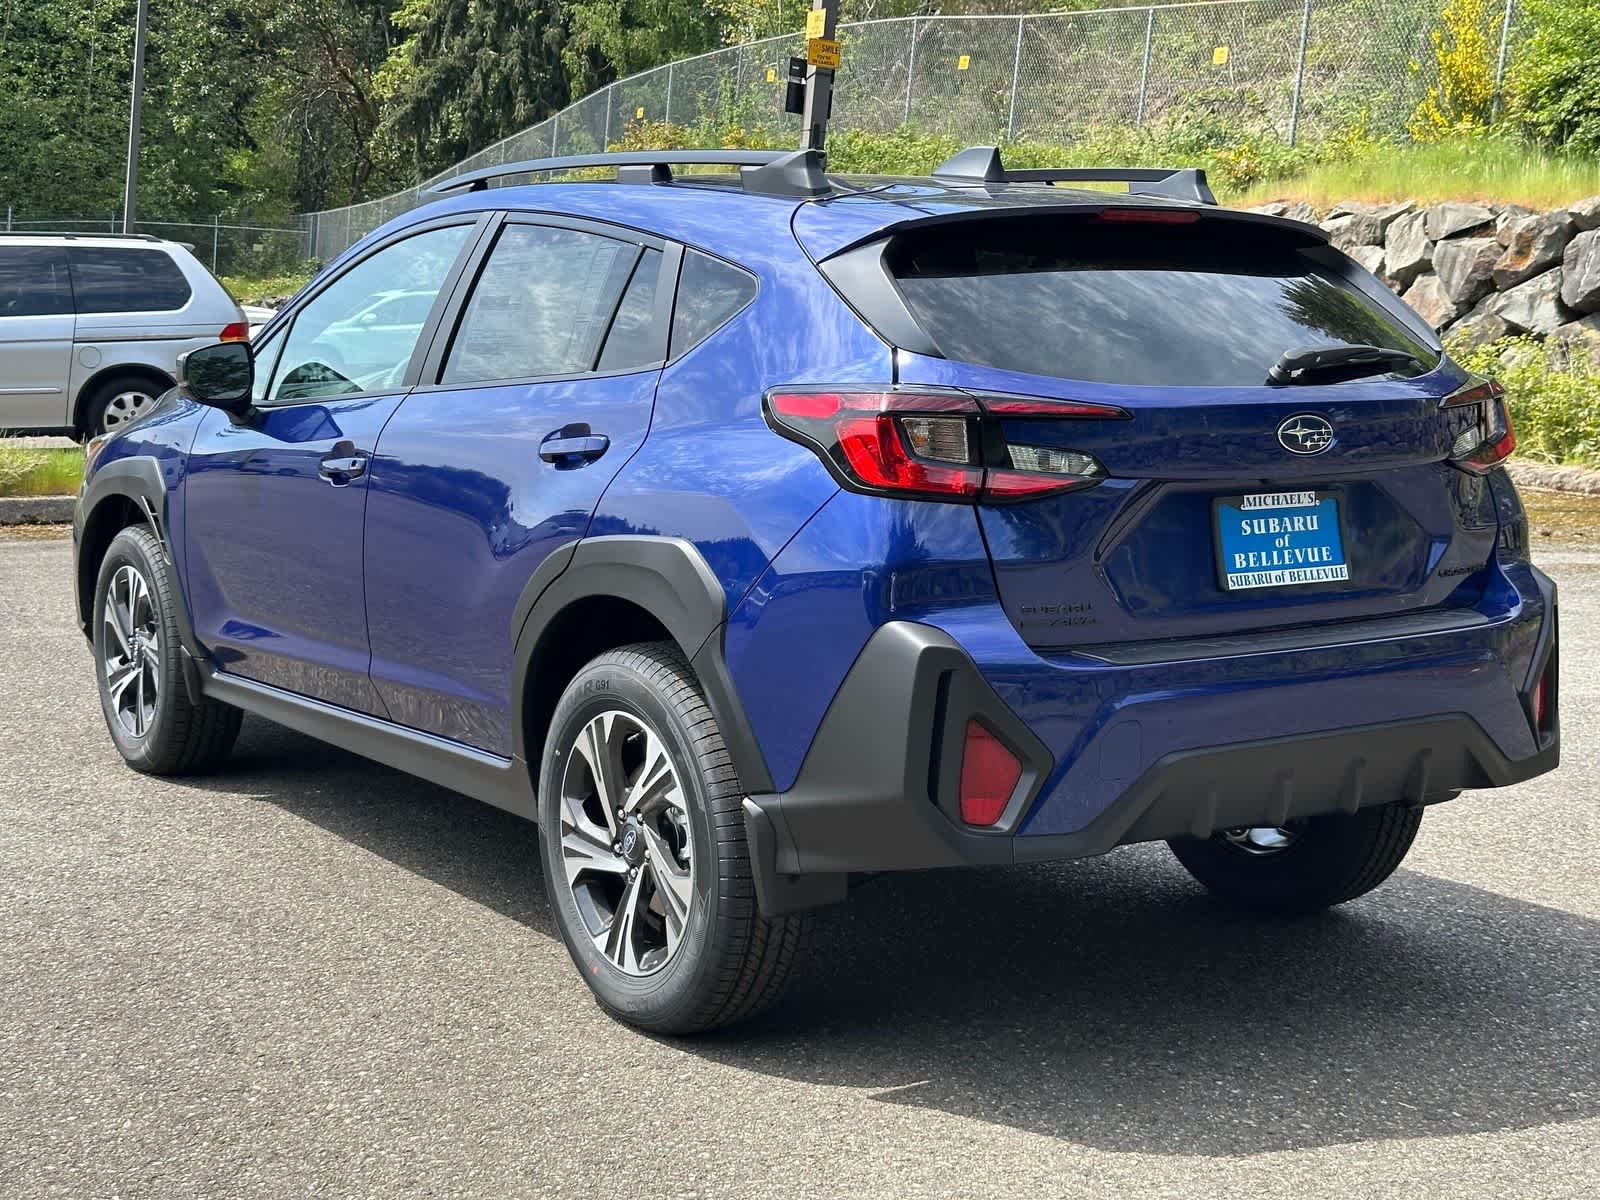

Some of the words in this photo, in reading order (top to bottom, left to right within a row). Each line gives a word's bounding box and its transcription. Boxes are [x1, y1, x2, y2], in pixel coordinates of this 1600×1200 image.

[1244, 492, 1315, 508] MICHAEL'S
[1241, 515, 1319, 536] SUBARU
[1275, 534, 1289, 548] of
[1234, 546, 1333, 569] BELLEVUE
[1230, 572, 1273, 588] SUBARU
[1275, 571, 1286, 584] of
[1290, 566, 1347, 583] BELLEVUE
